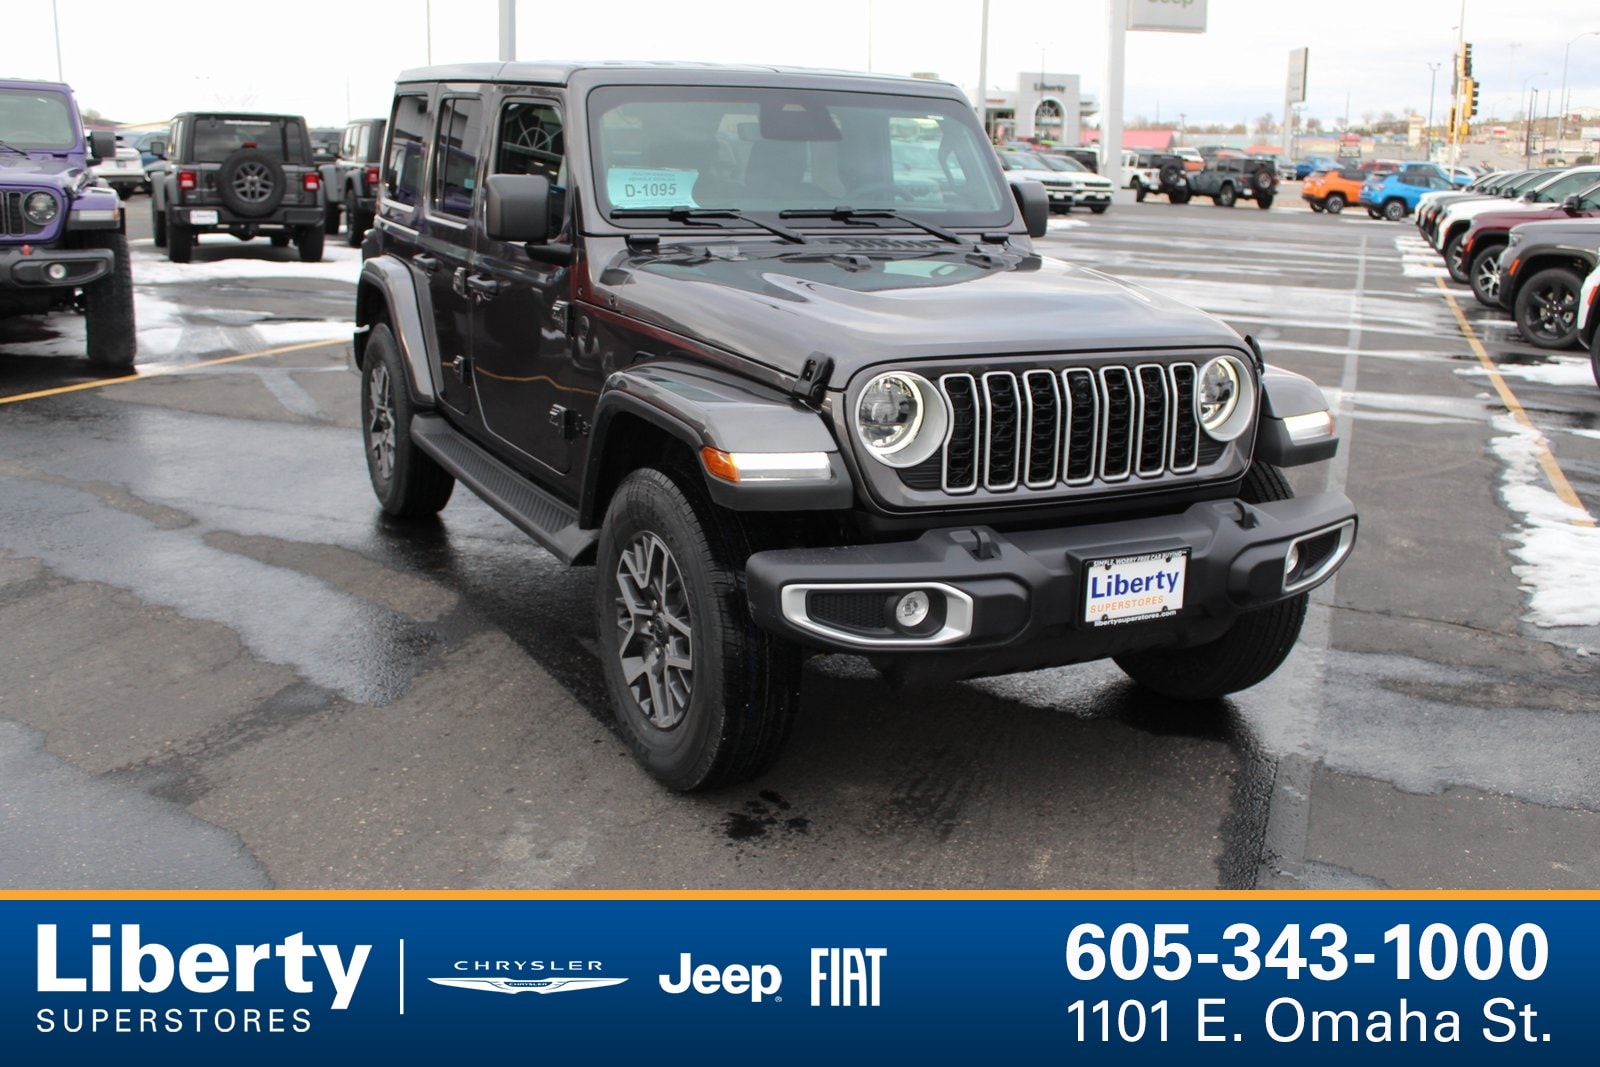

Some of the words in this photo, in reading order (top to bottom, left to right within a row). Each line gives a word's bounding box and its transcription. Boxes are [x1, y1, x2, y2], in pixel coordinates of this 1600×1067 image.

[1033, 82, 1066, 94] Liberty
[625, 183, 677, 198] D-1095
[1091, 570, 1180, 599] Liberty
[1090, 595, 1165, 614] SUPERSTORES
[1094, 610, 1177, 627] libertysuperstores.com
